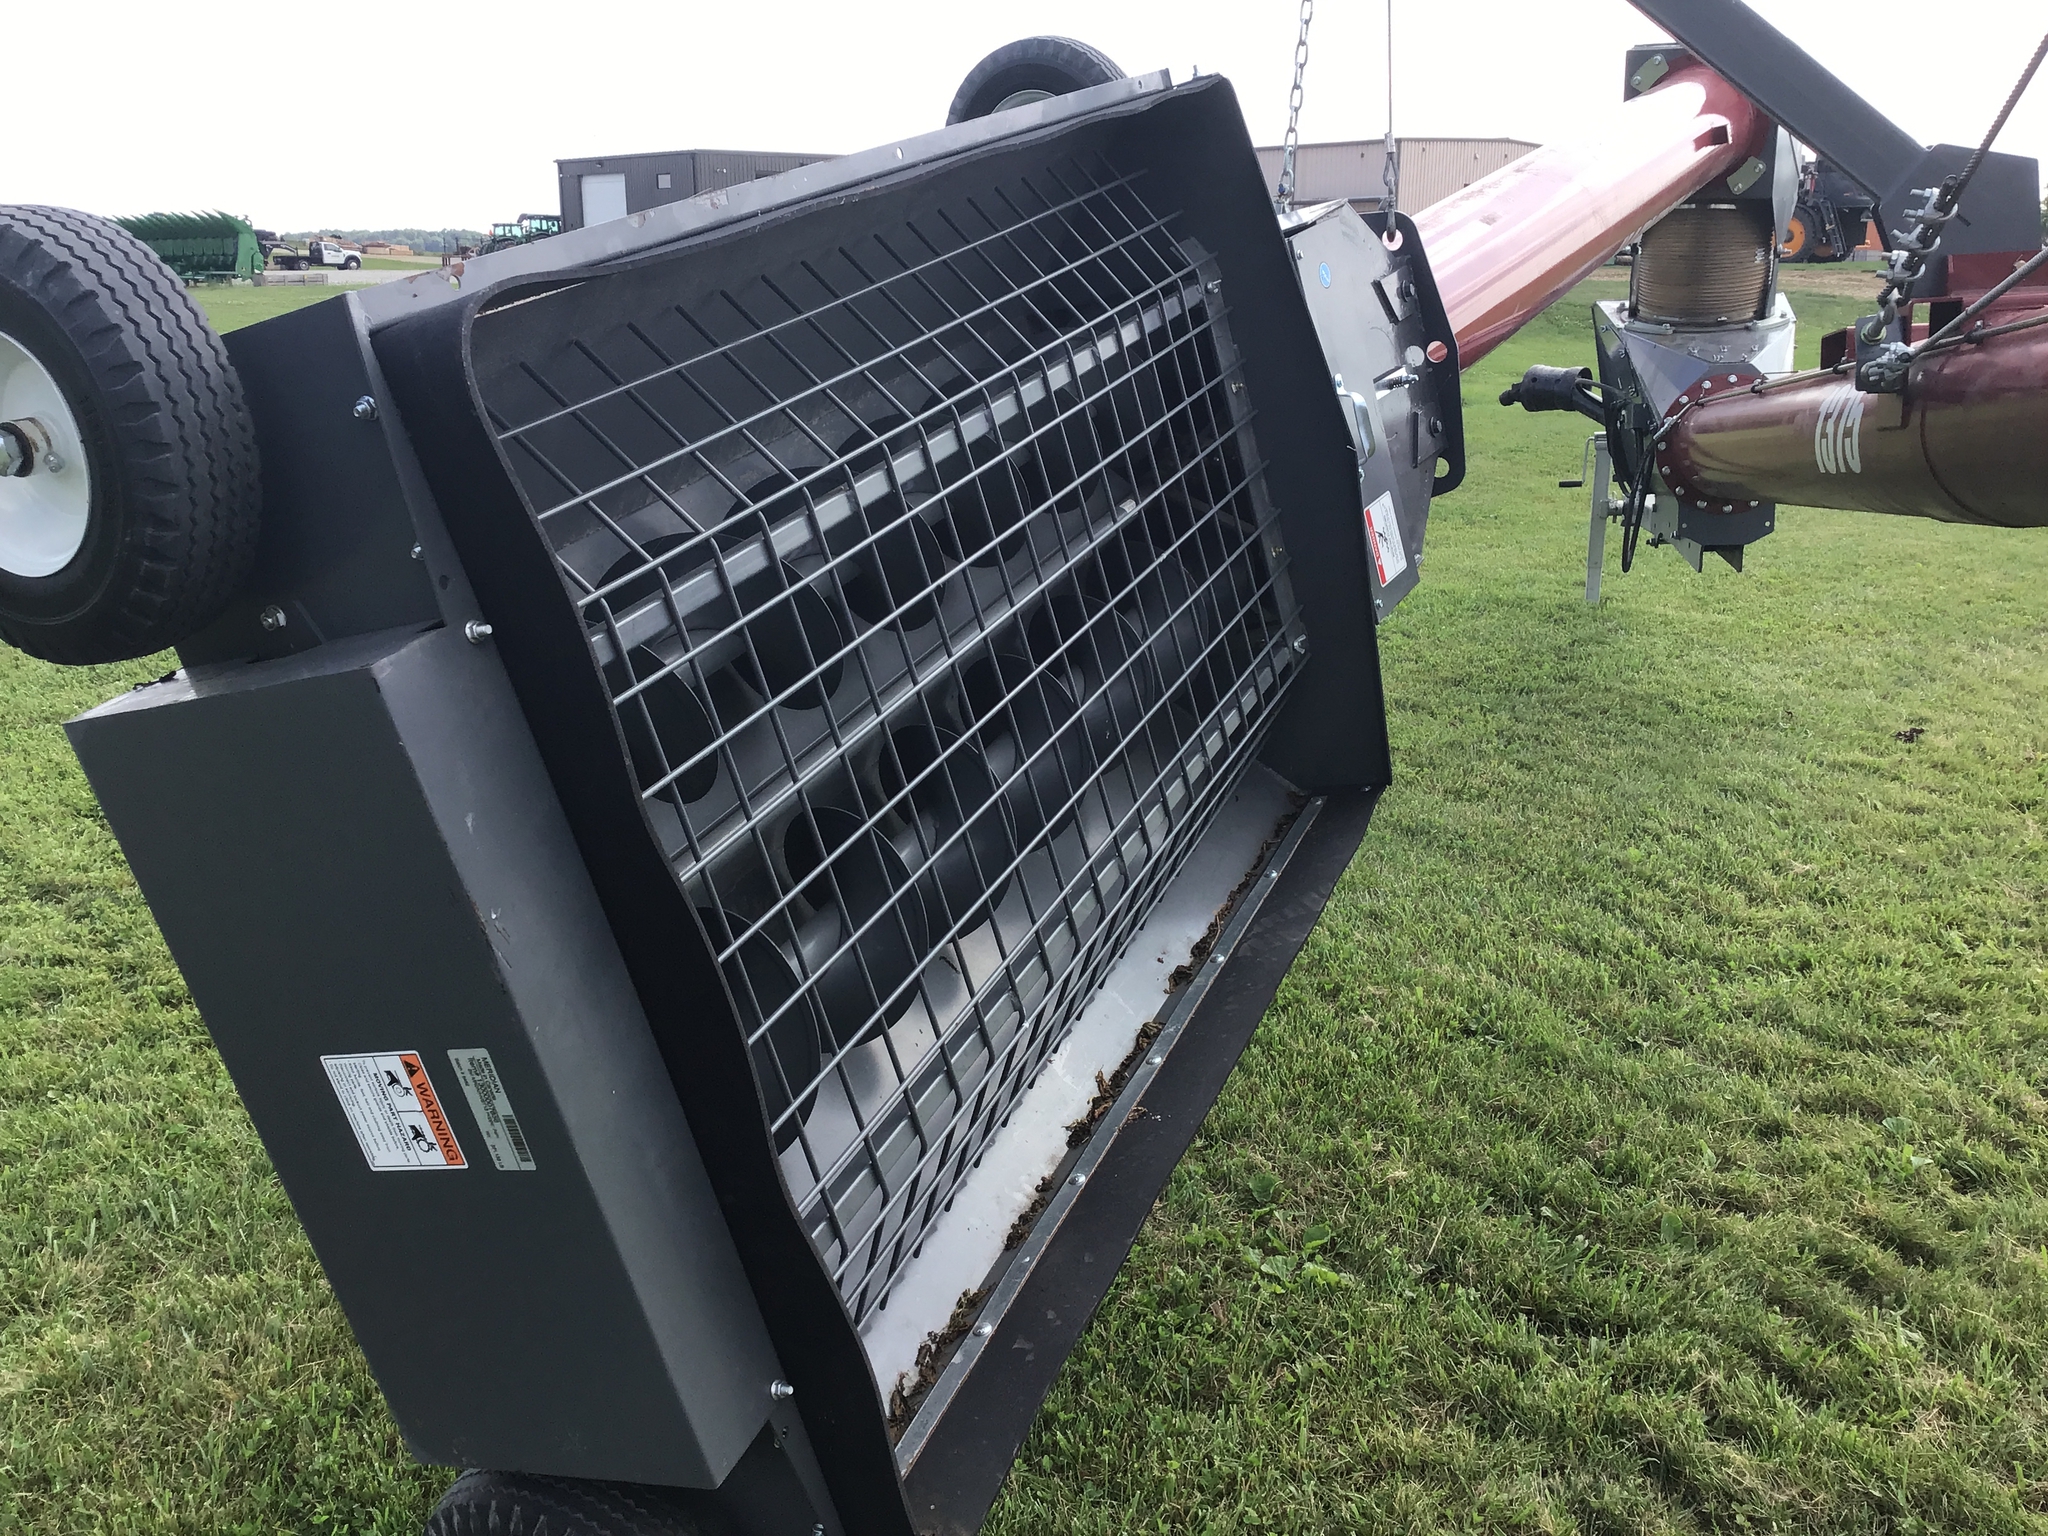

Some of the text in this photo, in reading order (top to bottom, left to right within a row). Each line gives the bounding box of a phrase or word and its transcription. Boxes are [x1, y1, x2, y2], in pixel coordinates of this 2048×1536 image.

[373, 1072, 389, 1100] MOVING
[385, 1102, 398, 1120] PART
[394, 1122, 411, 1150] HAZARD
[482, 1057, 501, 1093] MERIDIAN
[416, 1082, 458, 1160] WARNING
